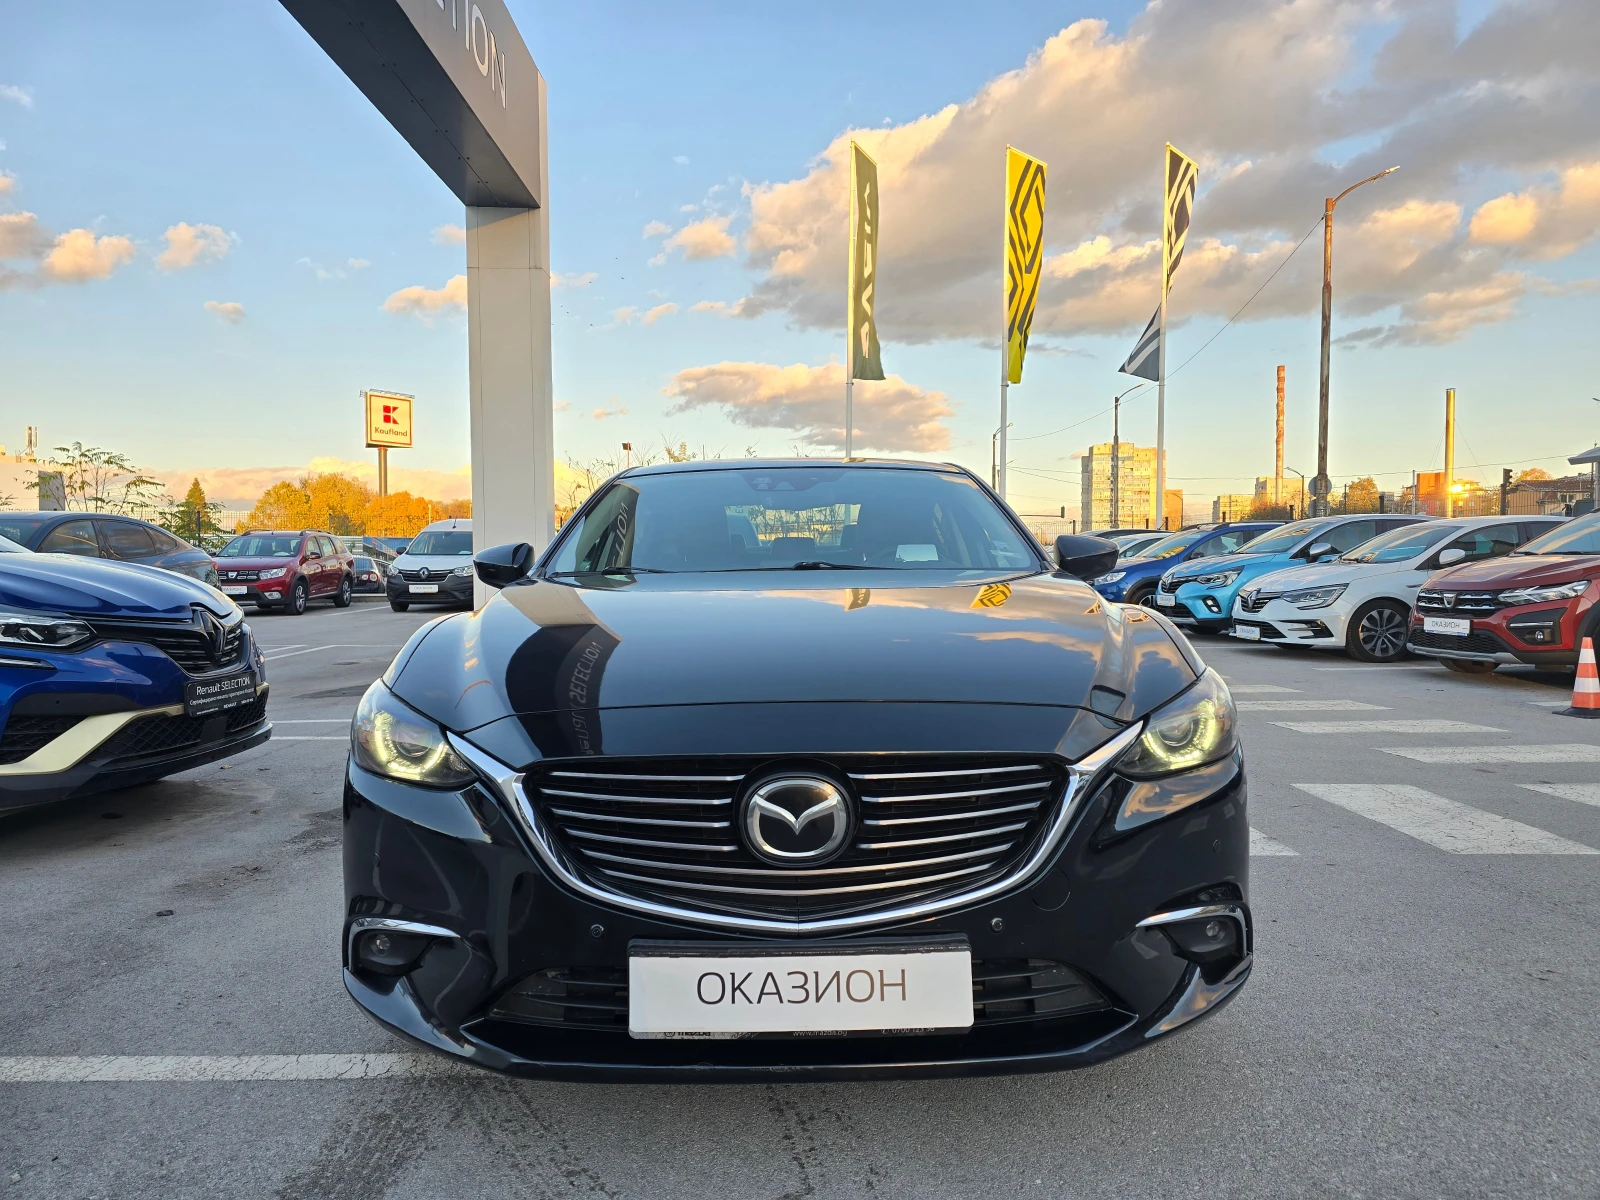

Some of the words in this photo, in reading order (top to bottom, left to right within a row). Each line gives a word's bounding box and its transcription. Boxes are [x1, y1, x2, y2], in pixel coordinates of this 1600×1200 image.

[374, 426, 408, 437] Kaufland
[196, 682, 220, 695] Renault
[221, 677, 251, 690] SELECTION
[696, 968, 908, 1005] ОКАЗИОН
